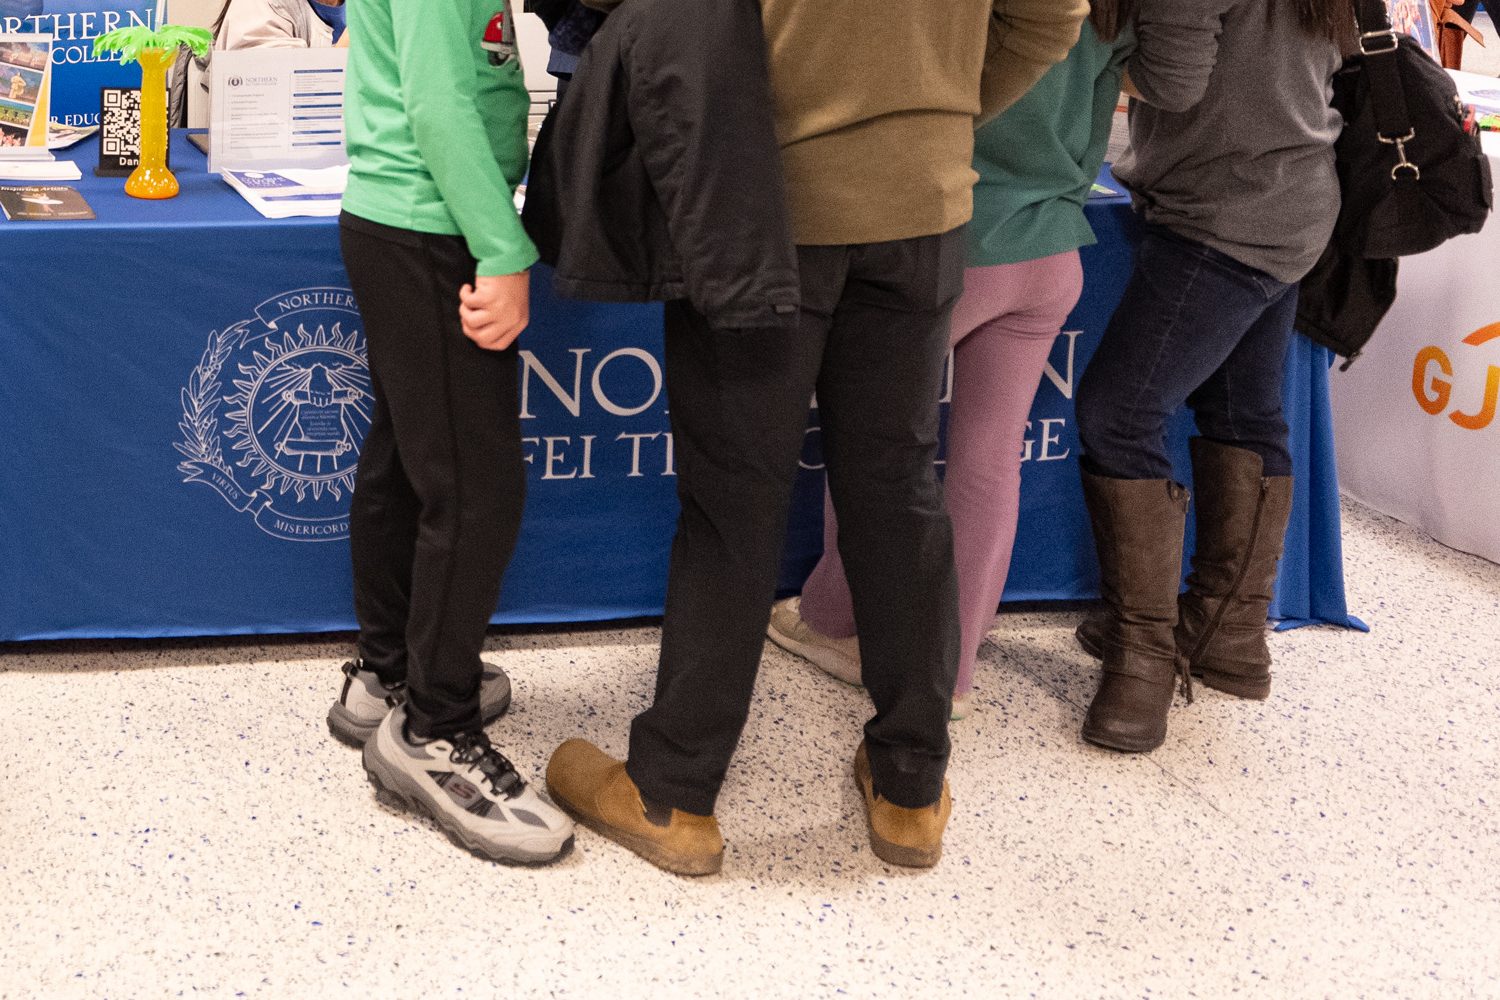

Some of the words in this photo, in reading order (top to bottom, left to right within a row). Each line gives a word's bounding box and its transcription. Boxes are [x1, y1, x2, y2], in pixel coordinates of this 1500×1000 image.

[278, 292, 358, 313] NORTHER
[211, 472, 241, 500] VIRTUS
[274, 520, 350, 535] MISERICORD
